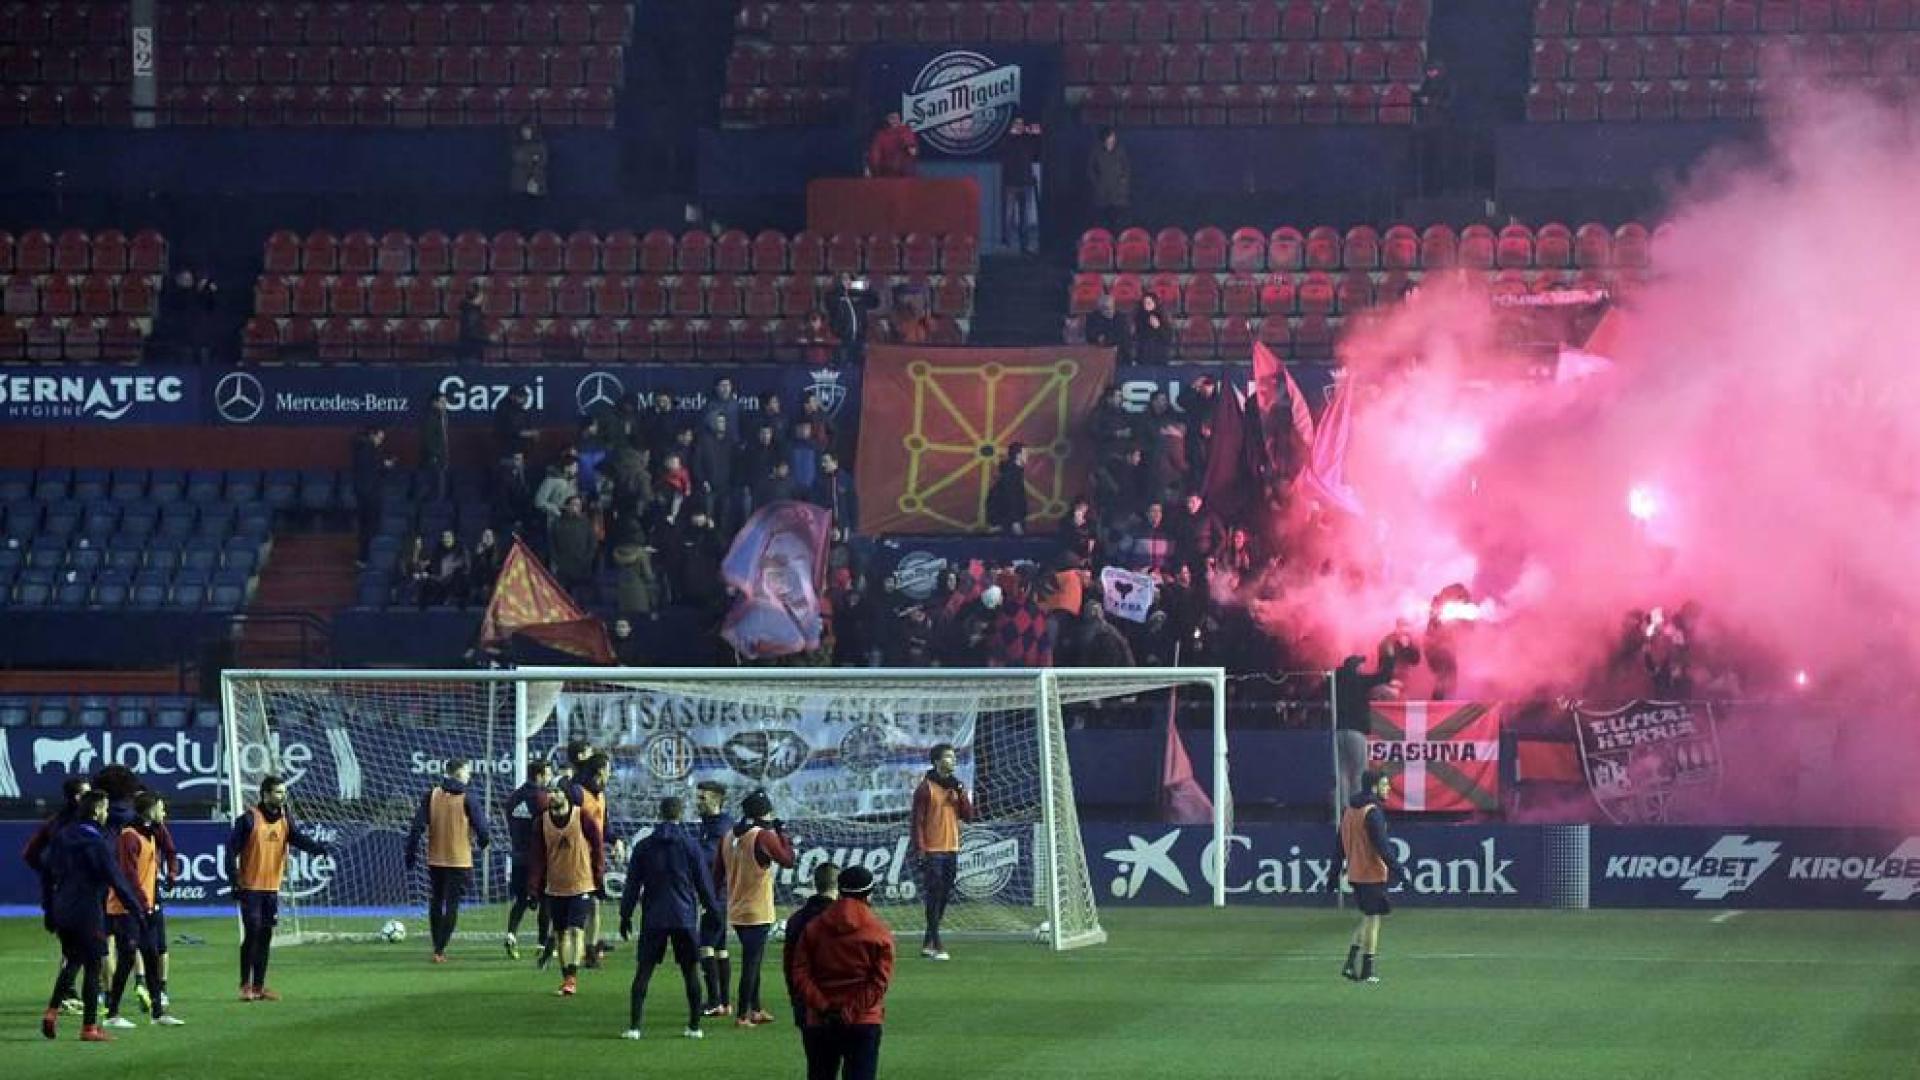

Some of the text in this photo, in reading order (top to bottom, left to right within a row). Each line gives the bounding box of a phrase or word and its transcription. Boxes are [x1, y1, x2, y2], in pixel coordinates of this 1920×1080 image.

[908, 96, 948, 126] San
[946, 72, 1016, 112] Miguel
[276, 392, 409, 412] Mercedes-Benz
[1606, 856, 1759, 878] KIROLBET
